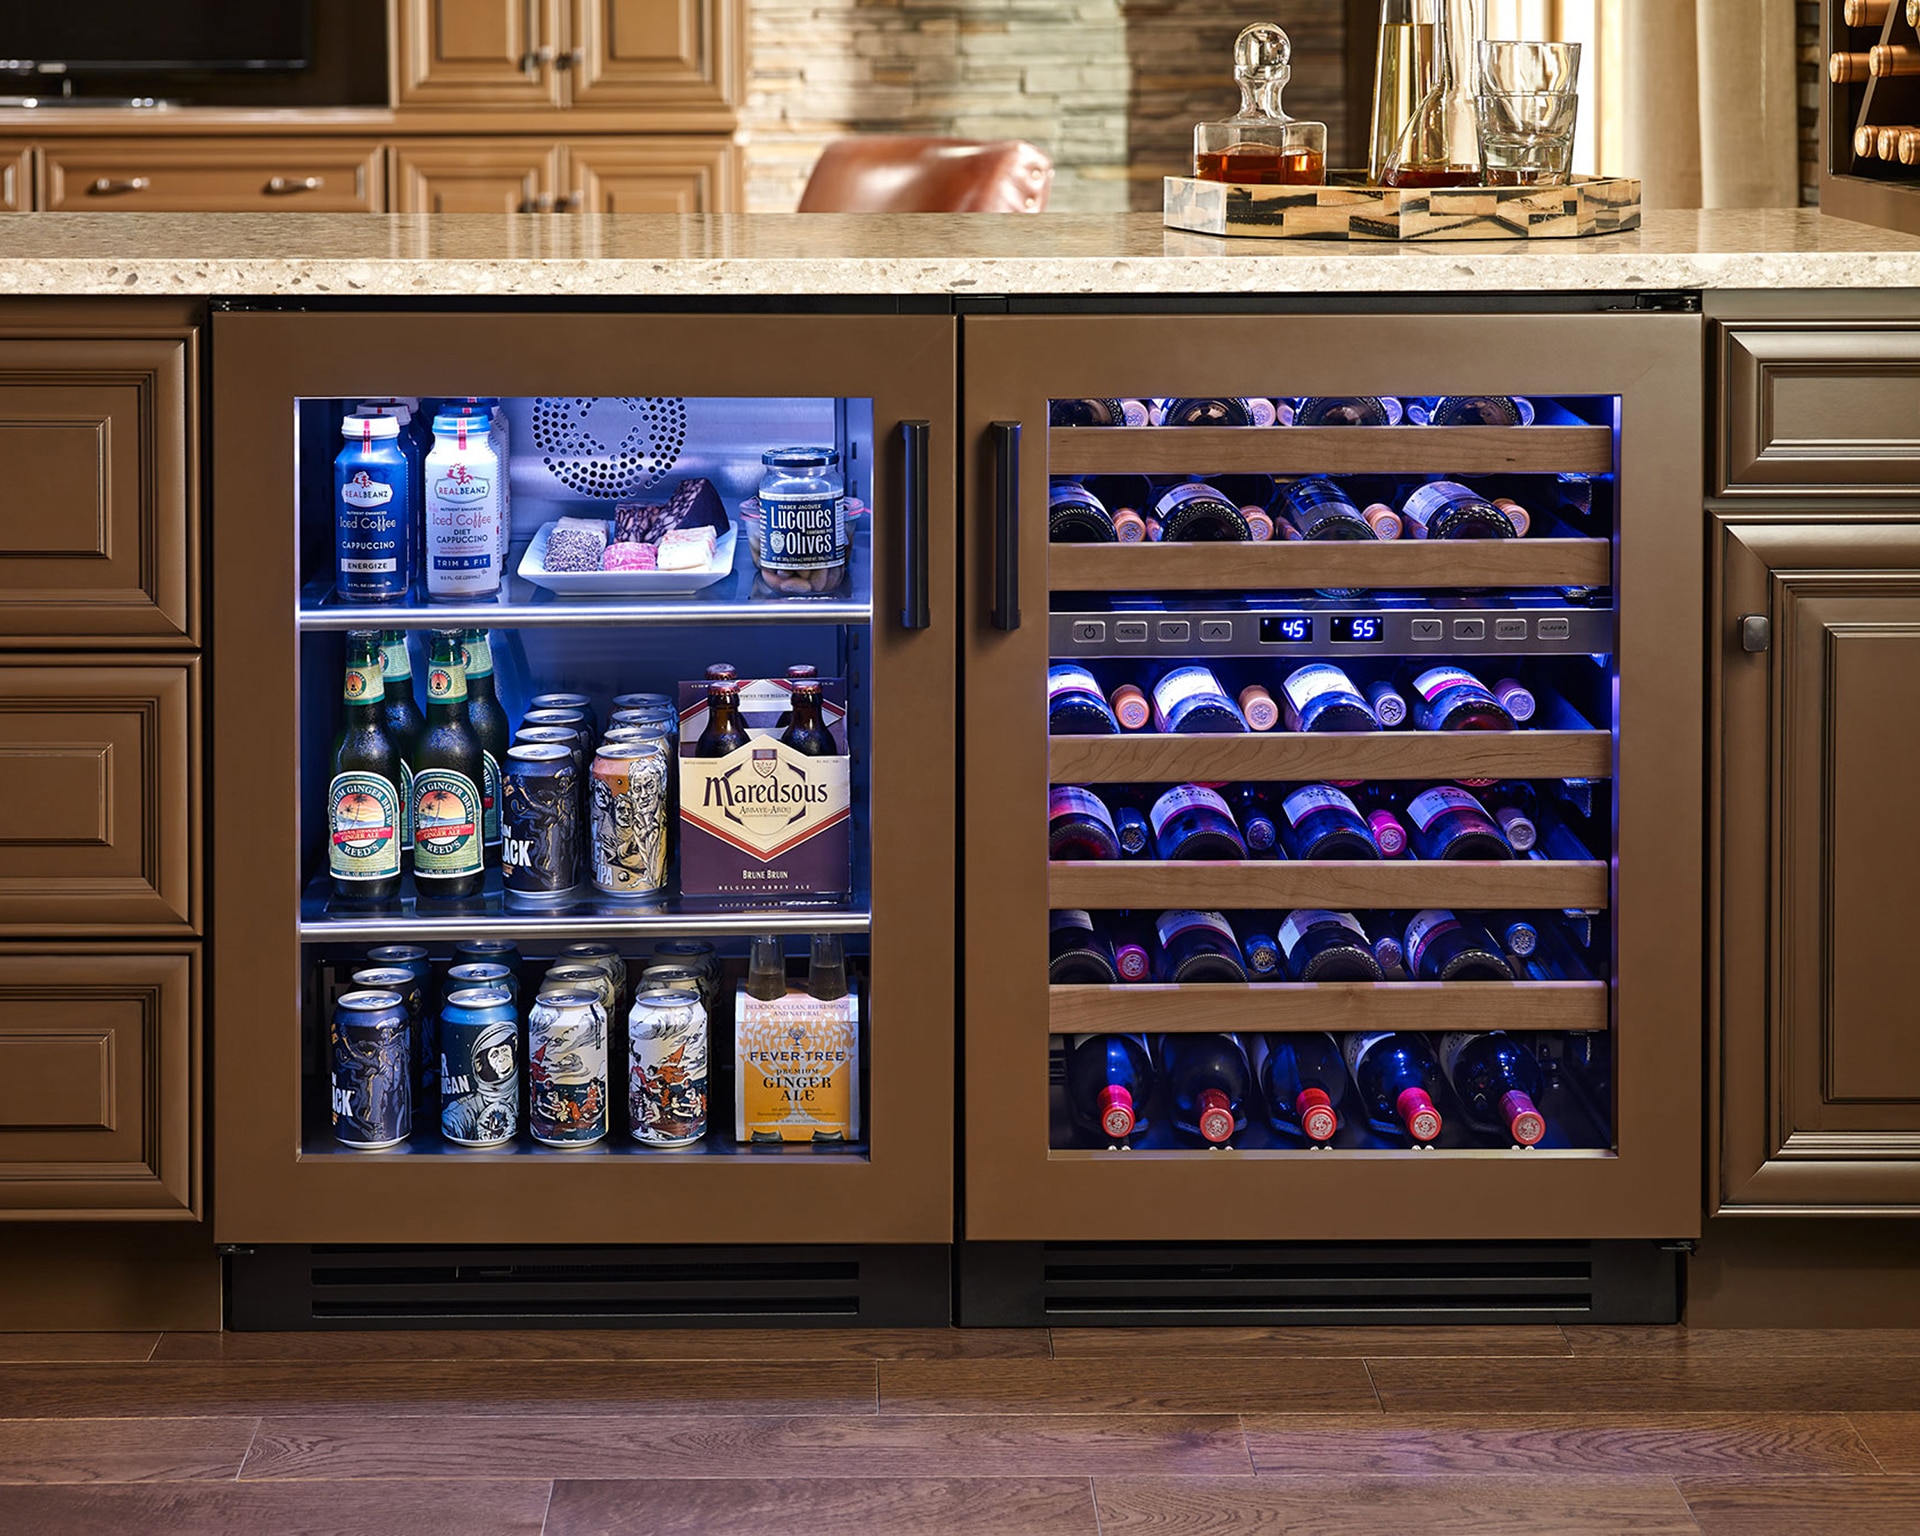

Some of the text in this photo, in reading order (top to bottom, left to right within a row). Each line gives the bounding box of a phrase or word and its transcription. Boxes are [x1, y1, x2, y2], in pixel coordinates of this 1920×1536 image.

[438, 486, 486, 495] REALBEANZ
[339, 516, 396, 532] Iced Coffee
[433, 512, 492, 528] Iced Coffee
[770, 506, 832, 533] Lucques
[342, 541, 395, 550] CAPPUCCINO
[436, 535, 488, 544] CAPPUCCINO
[786, 532, 832, 555] Olives
[437, 559, 460, 567] TRIM
[473, 558, 488, 566] FIT
[1282, 620, 1304, 638] 45
[703, 774, 828, 807] Maredsous
[347, 785, 384, 800] GINGER
[381, 796, 393, 826] BREW
[428, 782, 463, 798] GINGER
[462, 794, 474, 822] BREW
[344, 845, 380, 857] REED'S
[427, 840, 462, 854] REED'S
[502, 837, 532, 867] ACK
[742, 870, 788, 880] BRUNE BRUIN
[749, 1051, 845, 1061] FEVER-TREE
[763, 1077, 832, 1088] GINGER
[780, 1090, 816, 1102] ALE
